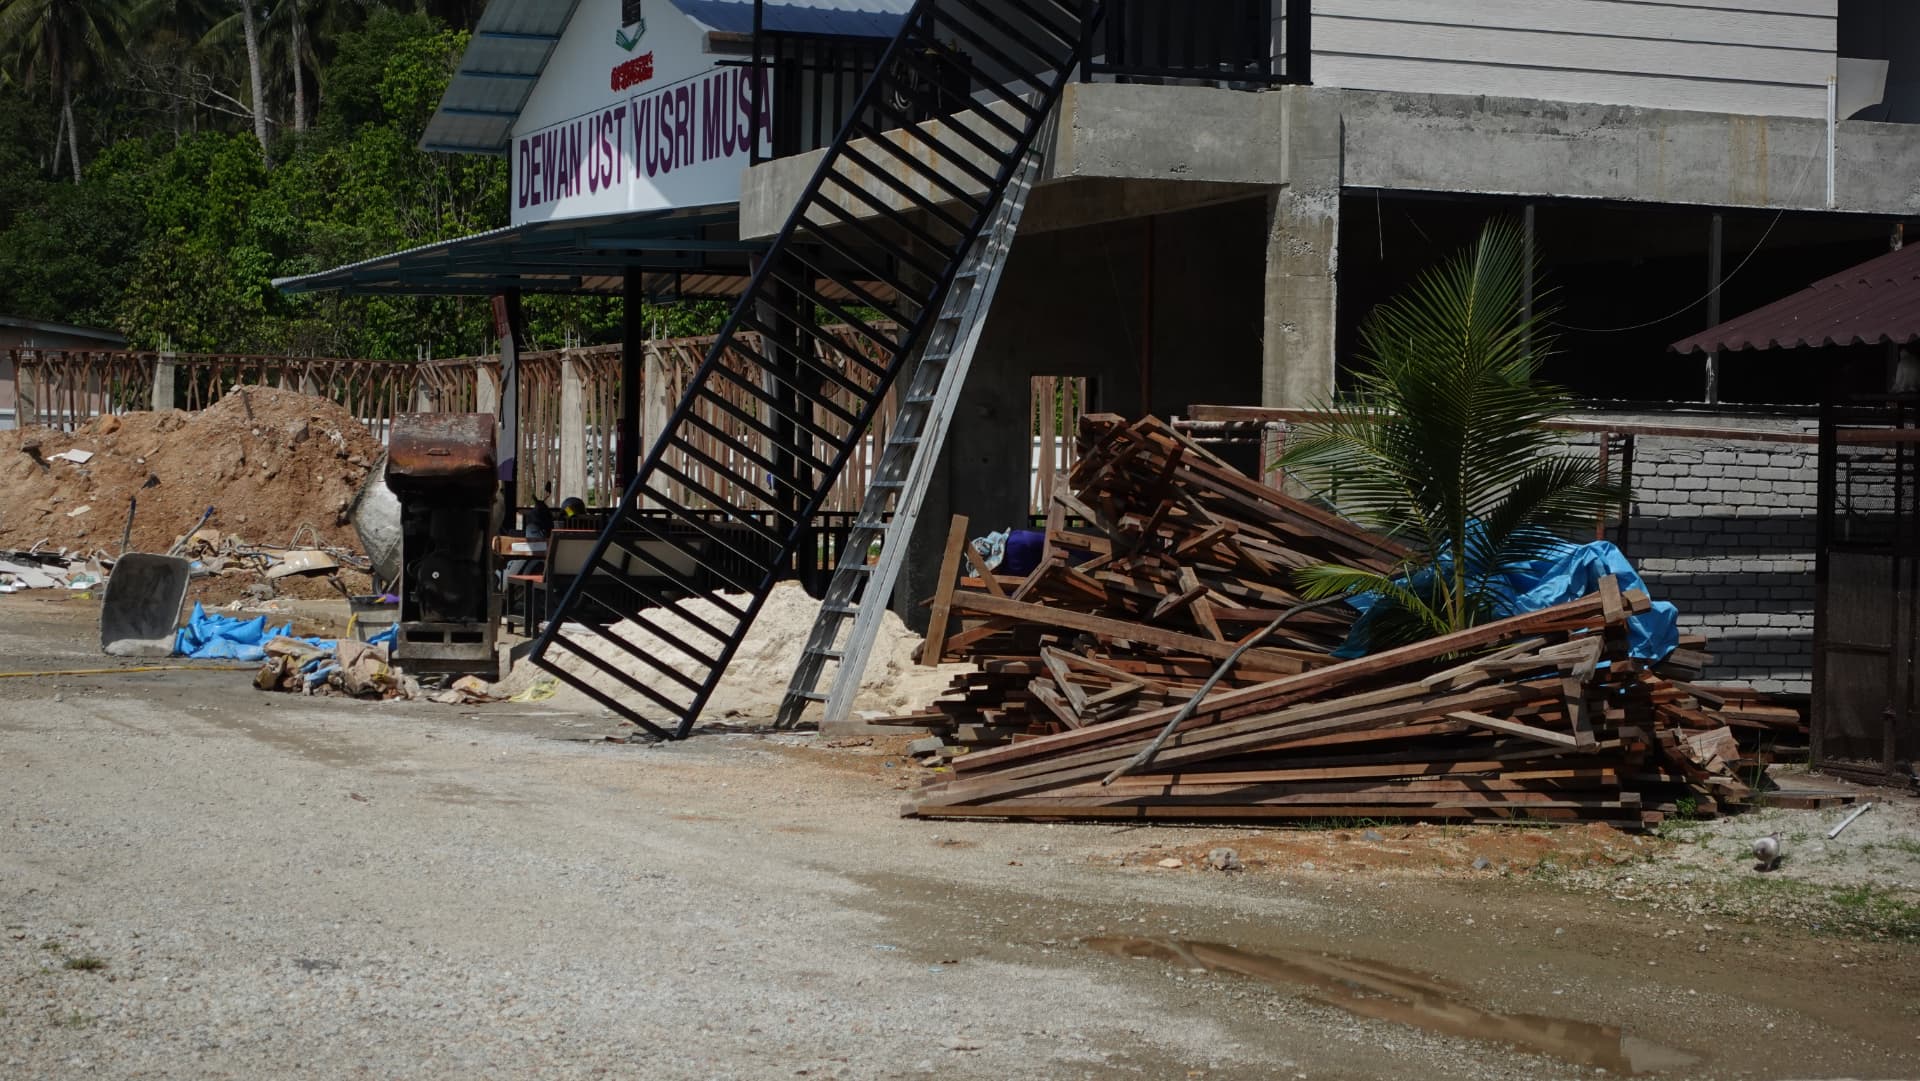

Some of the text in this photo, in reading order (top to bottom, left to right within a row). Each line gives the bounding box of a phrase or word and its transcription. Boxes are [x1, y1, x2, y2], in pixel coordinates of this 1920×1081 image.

[519, 121, 582, 209] DEWAN
[589, 106, 626, 193] UST
[633, 83, 695, 179] YUSRI
[702, 61, 772, 162] MUSA
